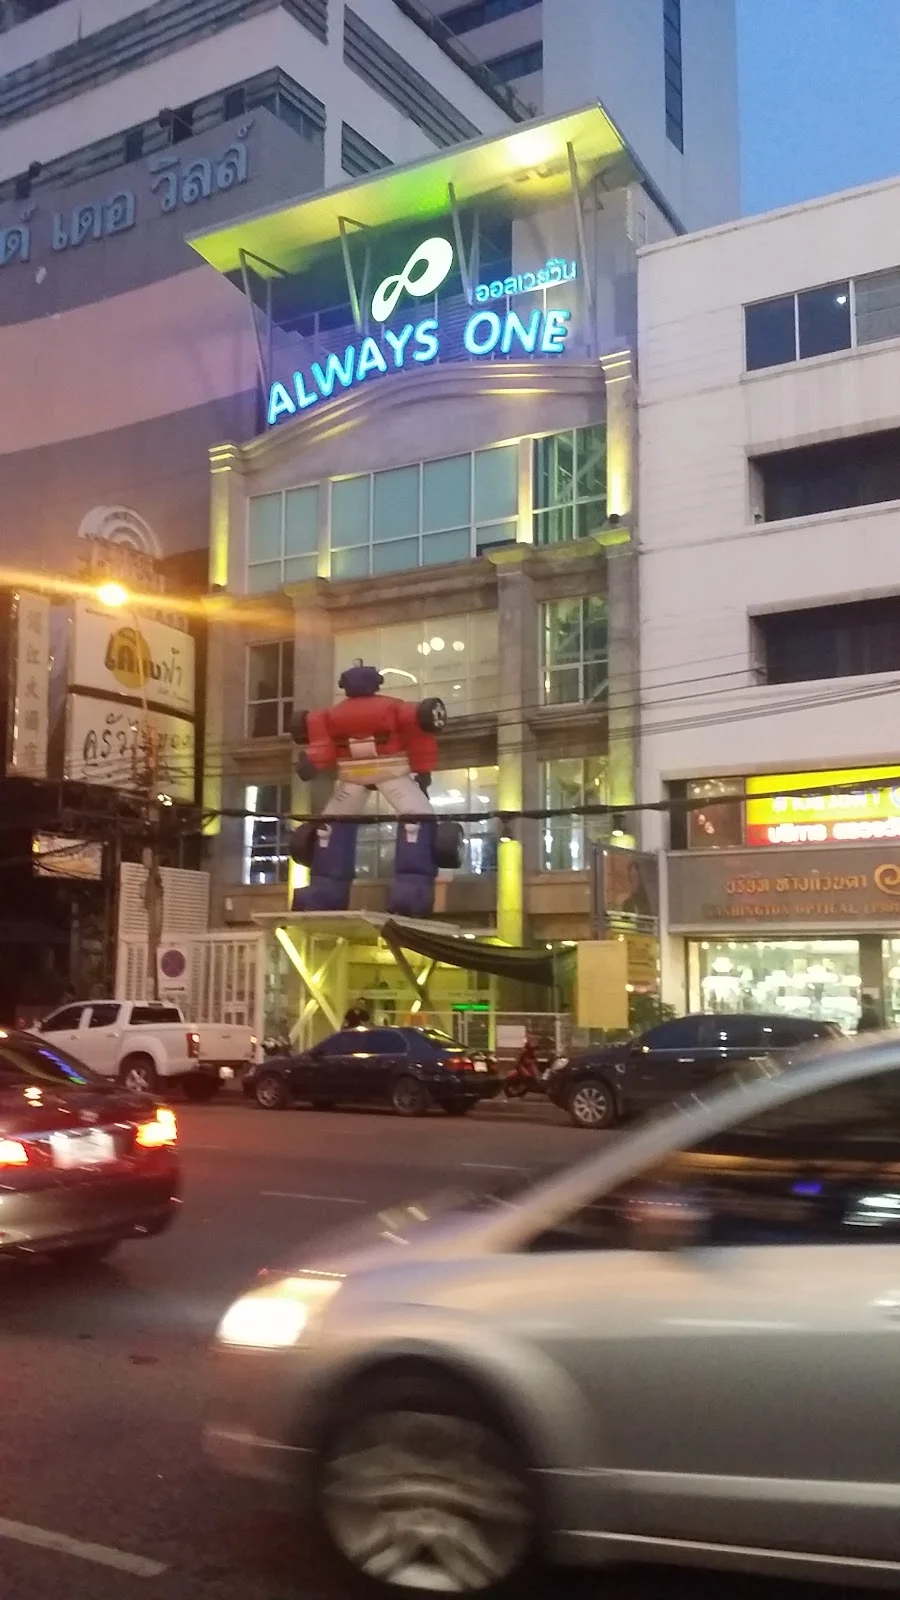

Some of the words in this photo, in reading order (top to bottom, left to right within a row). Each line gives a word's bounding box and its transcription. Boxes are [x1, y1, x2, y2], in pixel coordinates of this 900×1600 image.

[52, 188, 137, 251] เดอ
[150, 118, 256, 213] วิลล์
[267, 317, 439, 425] ALWAYS
[463, 308, 571, 356] ONE
